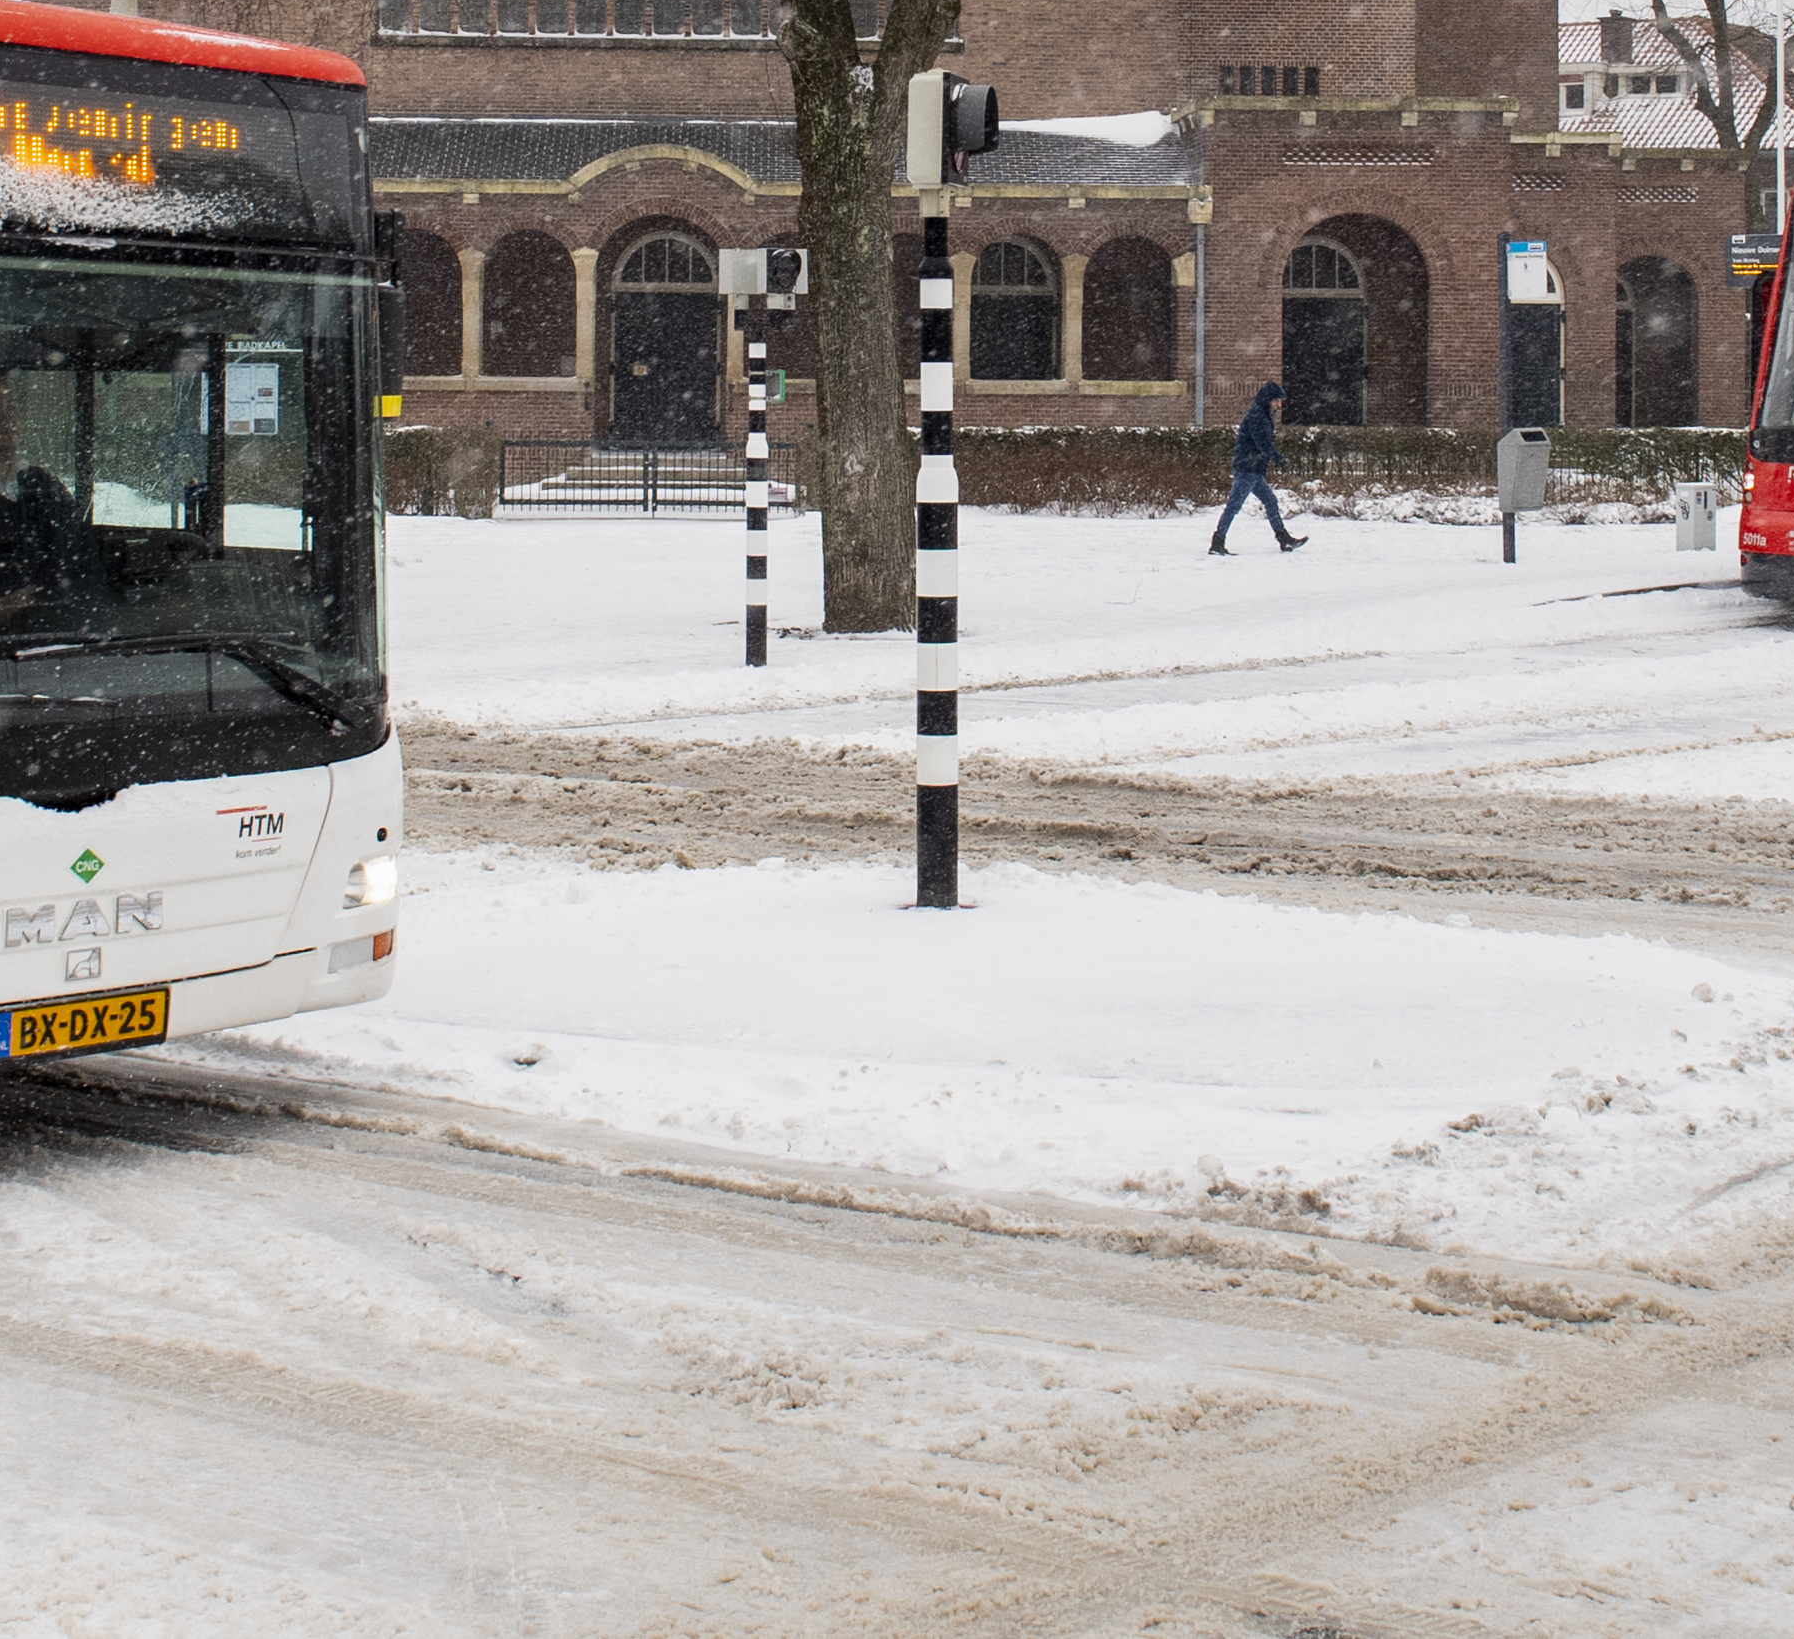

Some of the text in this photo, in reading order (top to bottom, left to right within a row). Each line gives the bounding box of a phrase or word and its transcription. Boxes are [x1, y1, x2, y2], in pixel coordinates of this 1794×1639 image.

[239, 812, 285, 838] HTM
[75, 859, 100, 874] CNG
[4, 892, 164, 949] MAN
[19, 998, 156, 1050] BX-DX-25
